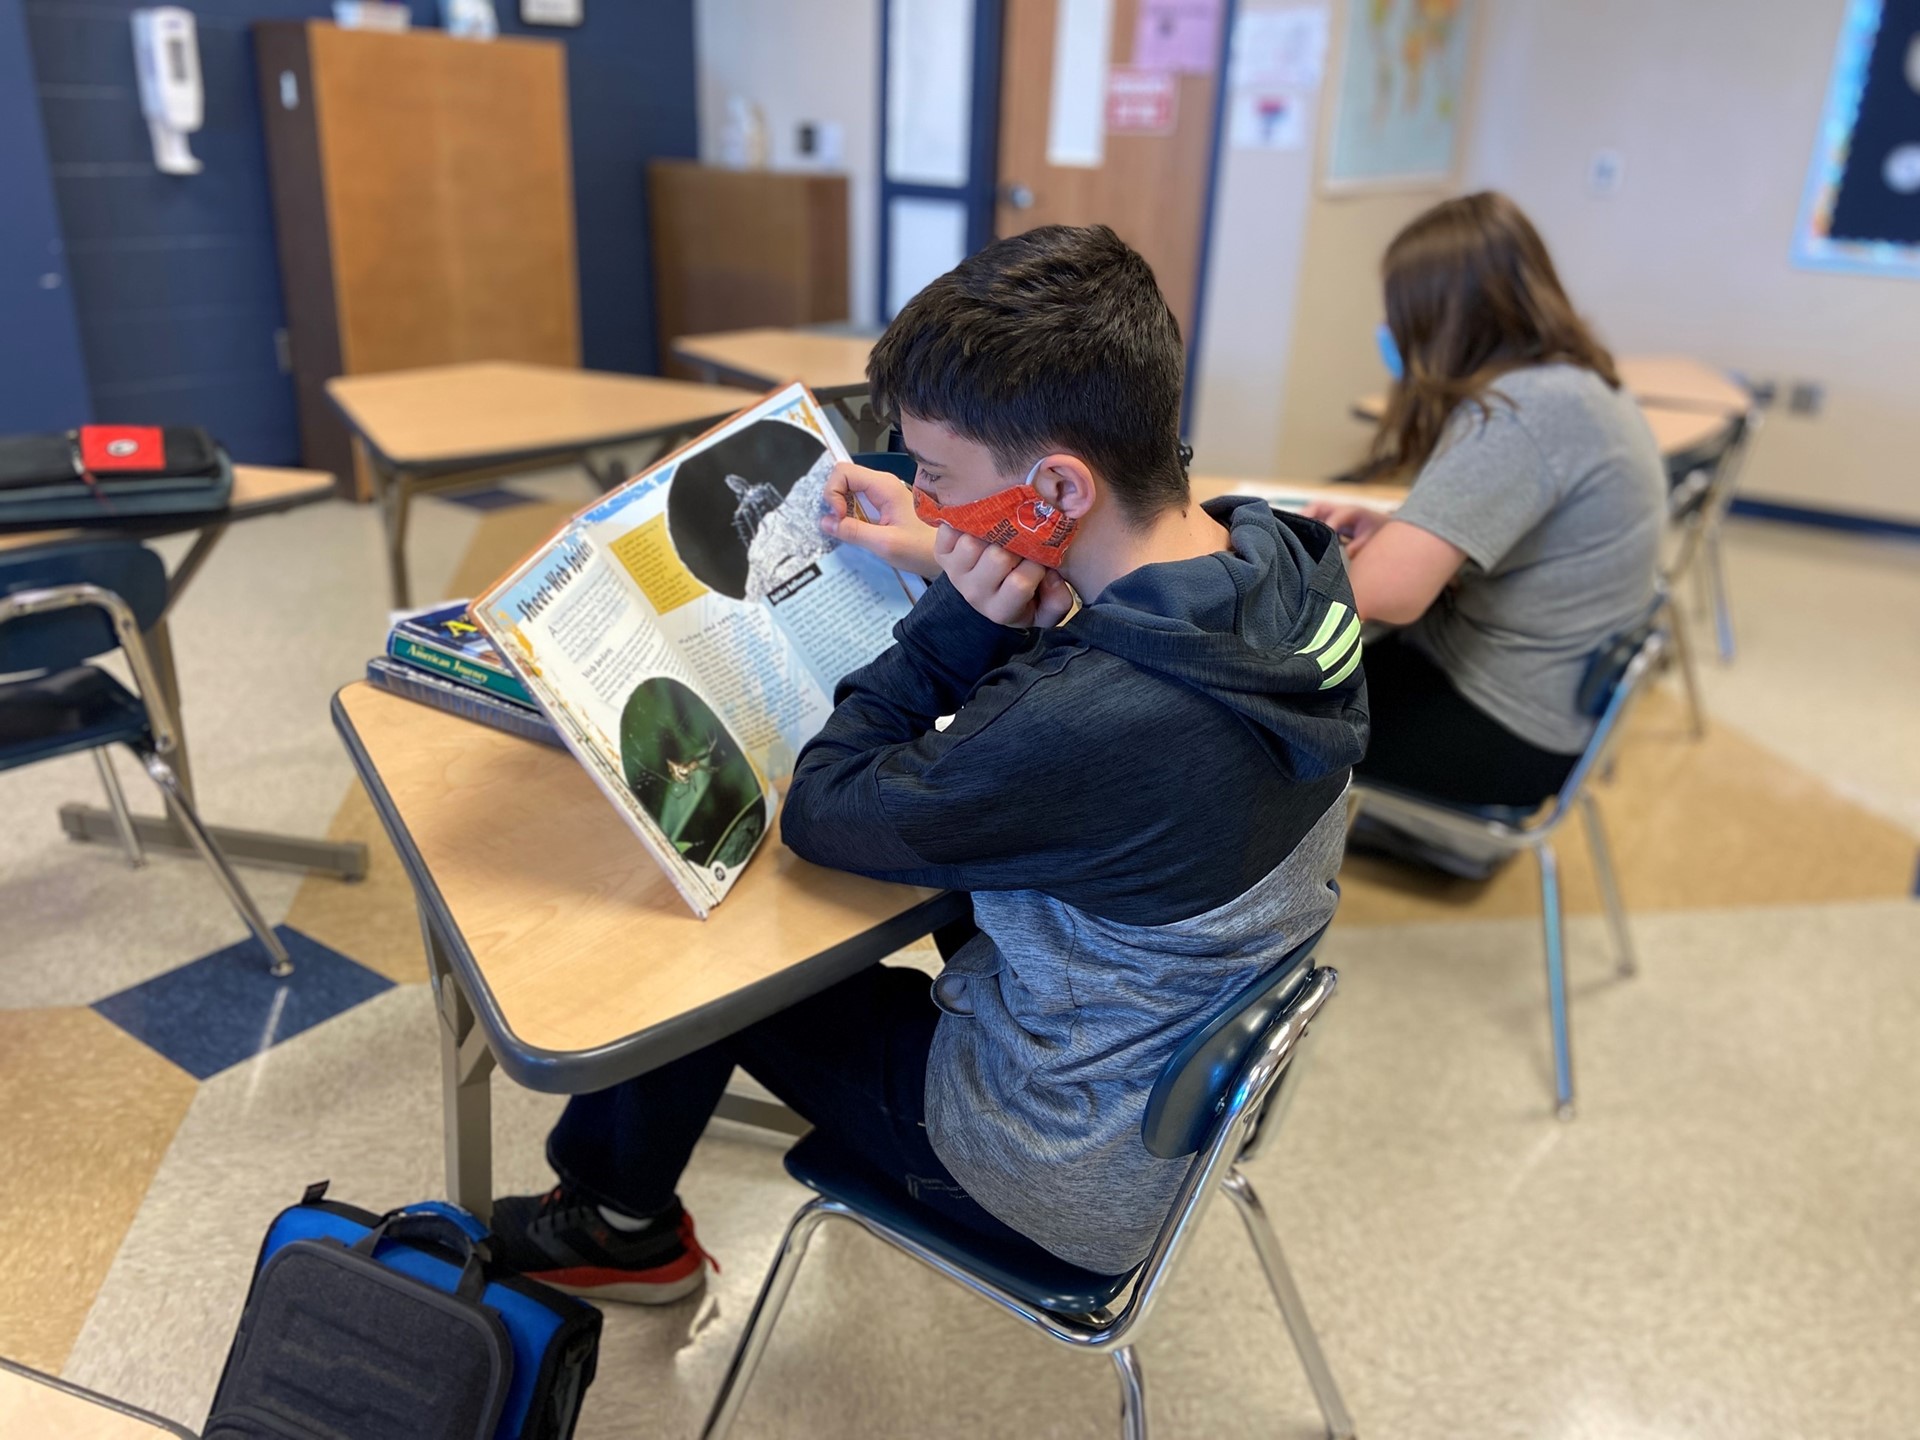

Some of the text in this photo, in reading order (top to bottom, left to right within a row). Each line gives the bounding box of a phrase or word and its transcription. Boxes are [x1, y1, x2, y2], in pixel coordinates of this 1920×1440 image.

[984, 518, 1011, 542] VELAND
[407, 643, 489, 683] American Journey
